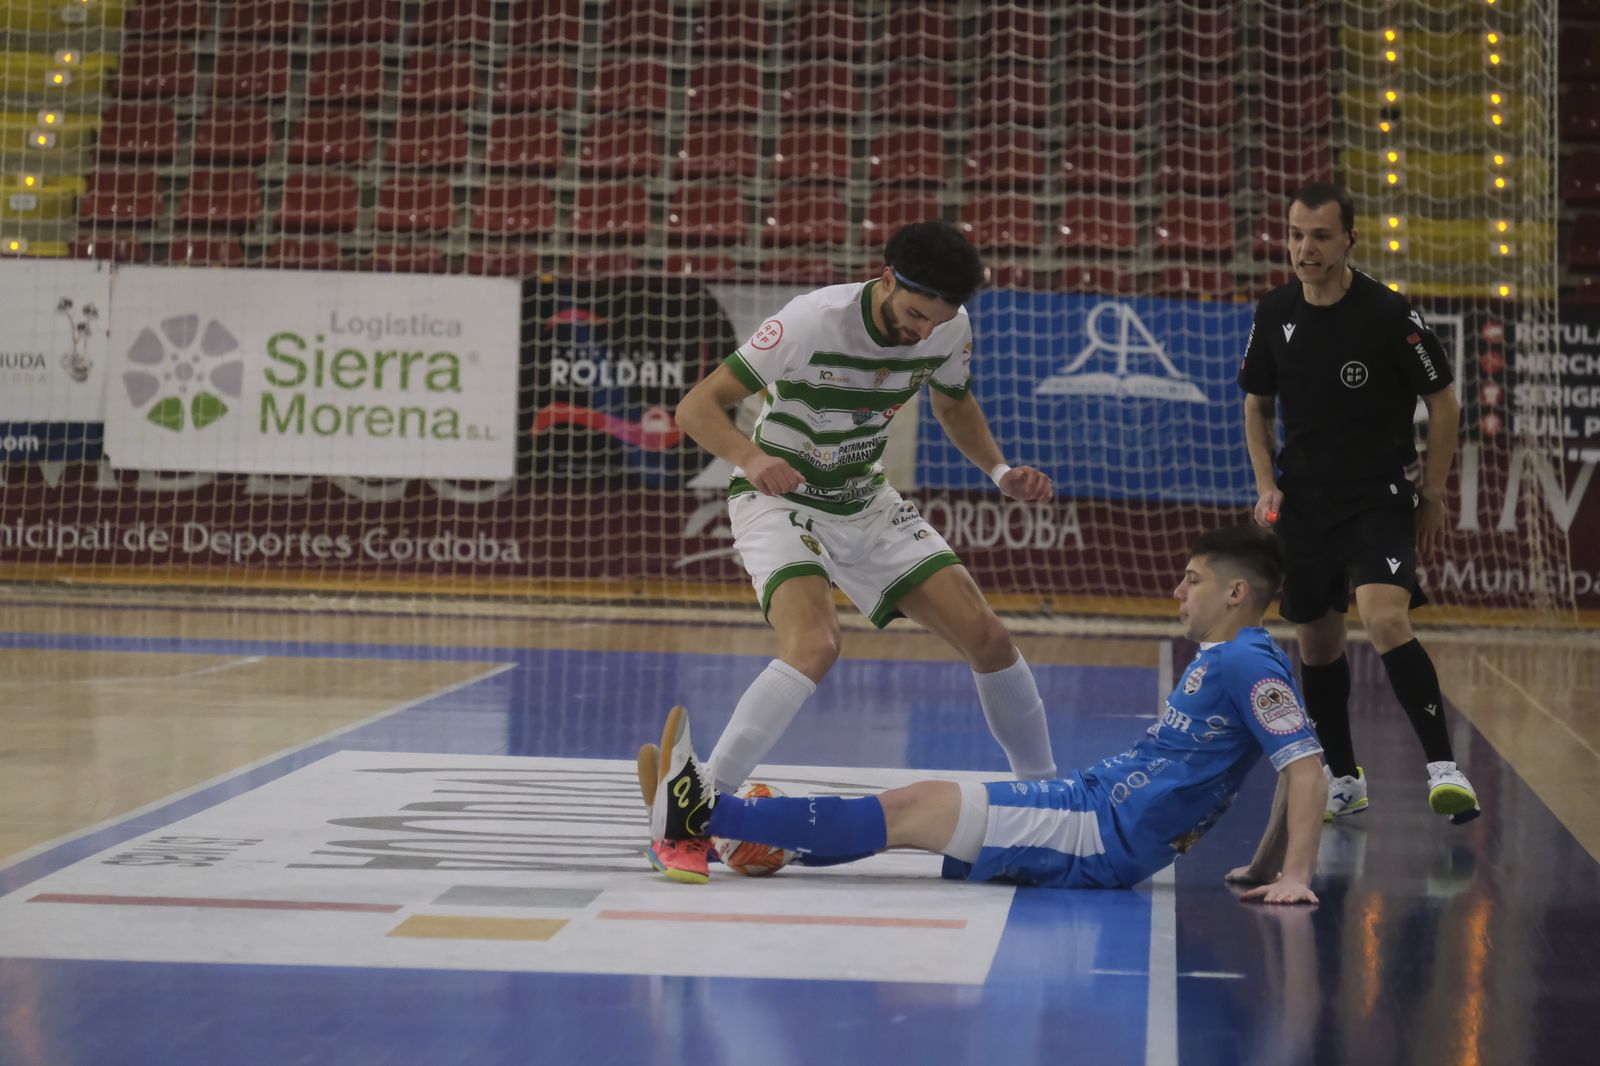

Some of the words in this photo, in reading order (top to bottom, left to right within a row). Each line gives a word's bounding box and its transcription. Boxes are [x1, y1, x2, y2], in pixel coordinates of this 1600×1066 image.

[330, 310, 463, 341] Logística
[262, 331, 462, 393] Sierra
[1414, 343, 1439, 382] WÜRTH
[259, 392, 461, 441] Morena
[0, 435, 39, 452] om
[122, 520, 169, 552] de
[181, 521, 351, 563] Deportes
[362, 527, 524, 564] Córdoba
